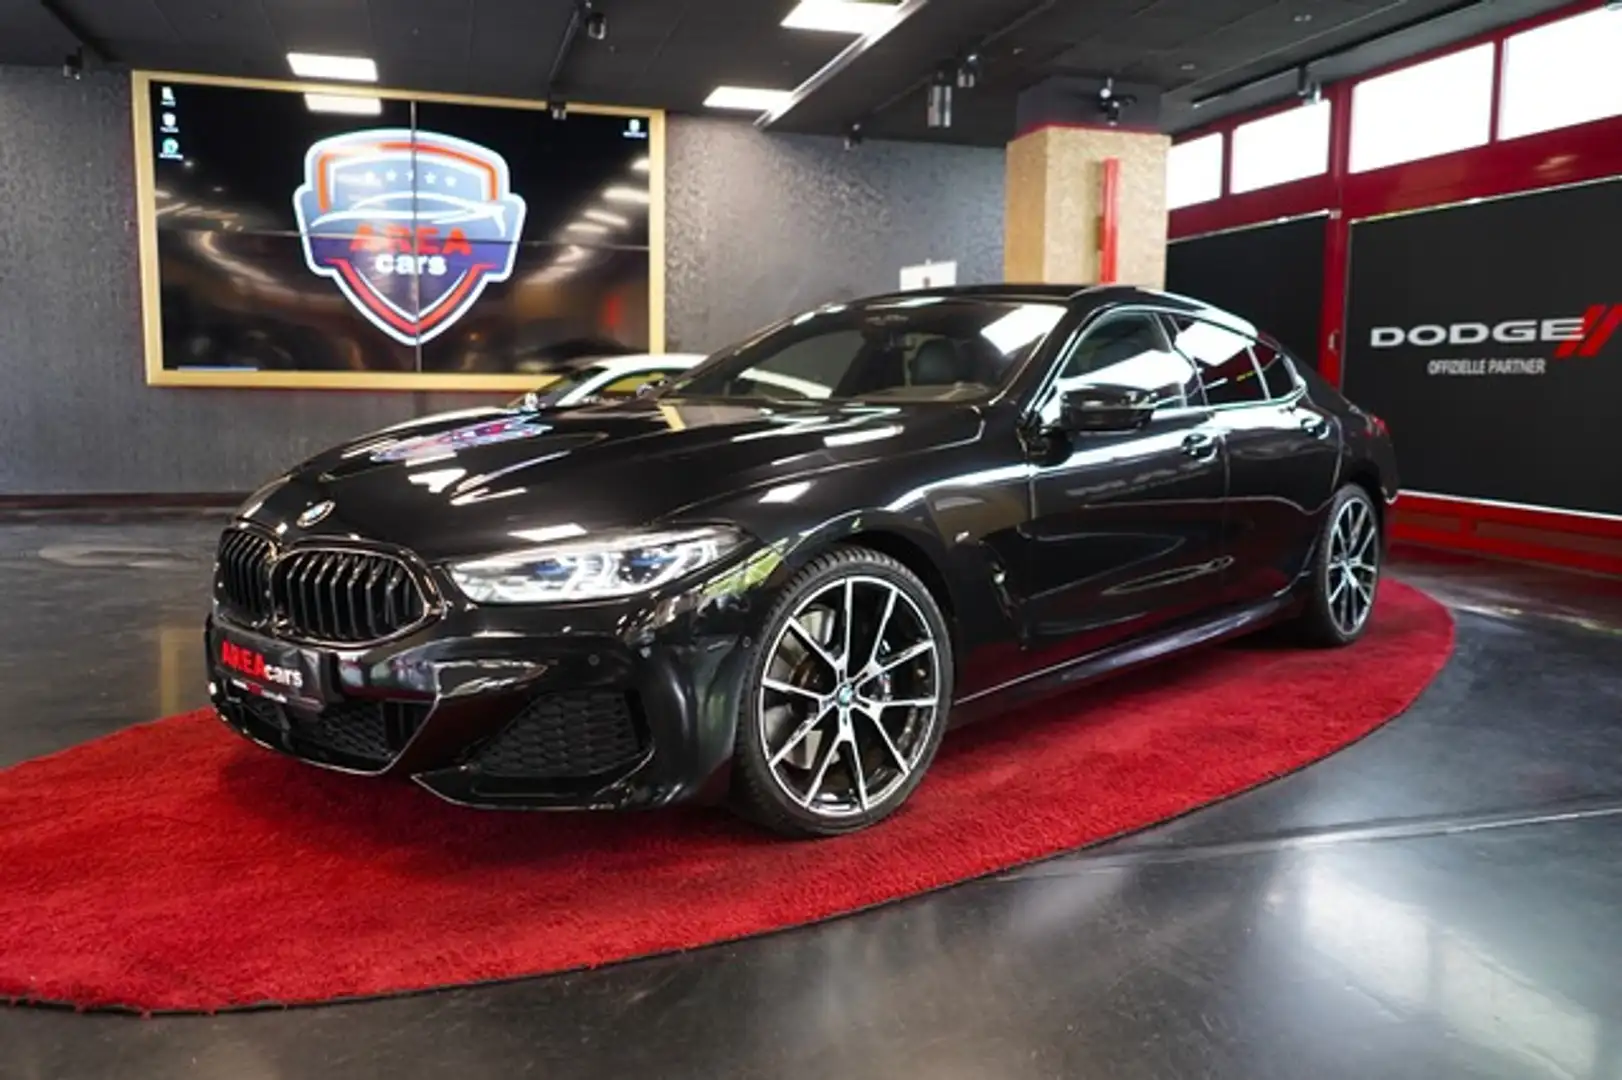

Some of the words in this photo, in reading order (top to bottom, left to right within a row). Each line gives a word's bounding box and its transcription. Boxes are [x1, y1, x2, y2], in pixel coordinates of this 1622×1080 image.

[349, 223, 473, 255] AREA
[375, 253, 447, 275] cars
[1370, 317, 1585, 347] DODGE
[1427, 358, 1486, 376] OFFIZIELLE
[1488, 357, 1546, 375] PARTNER
